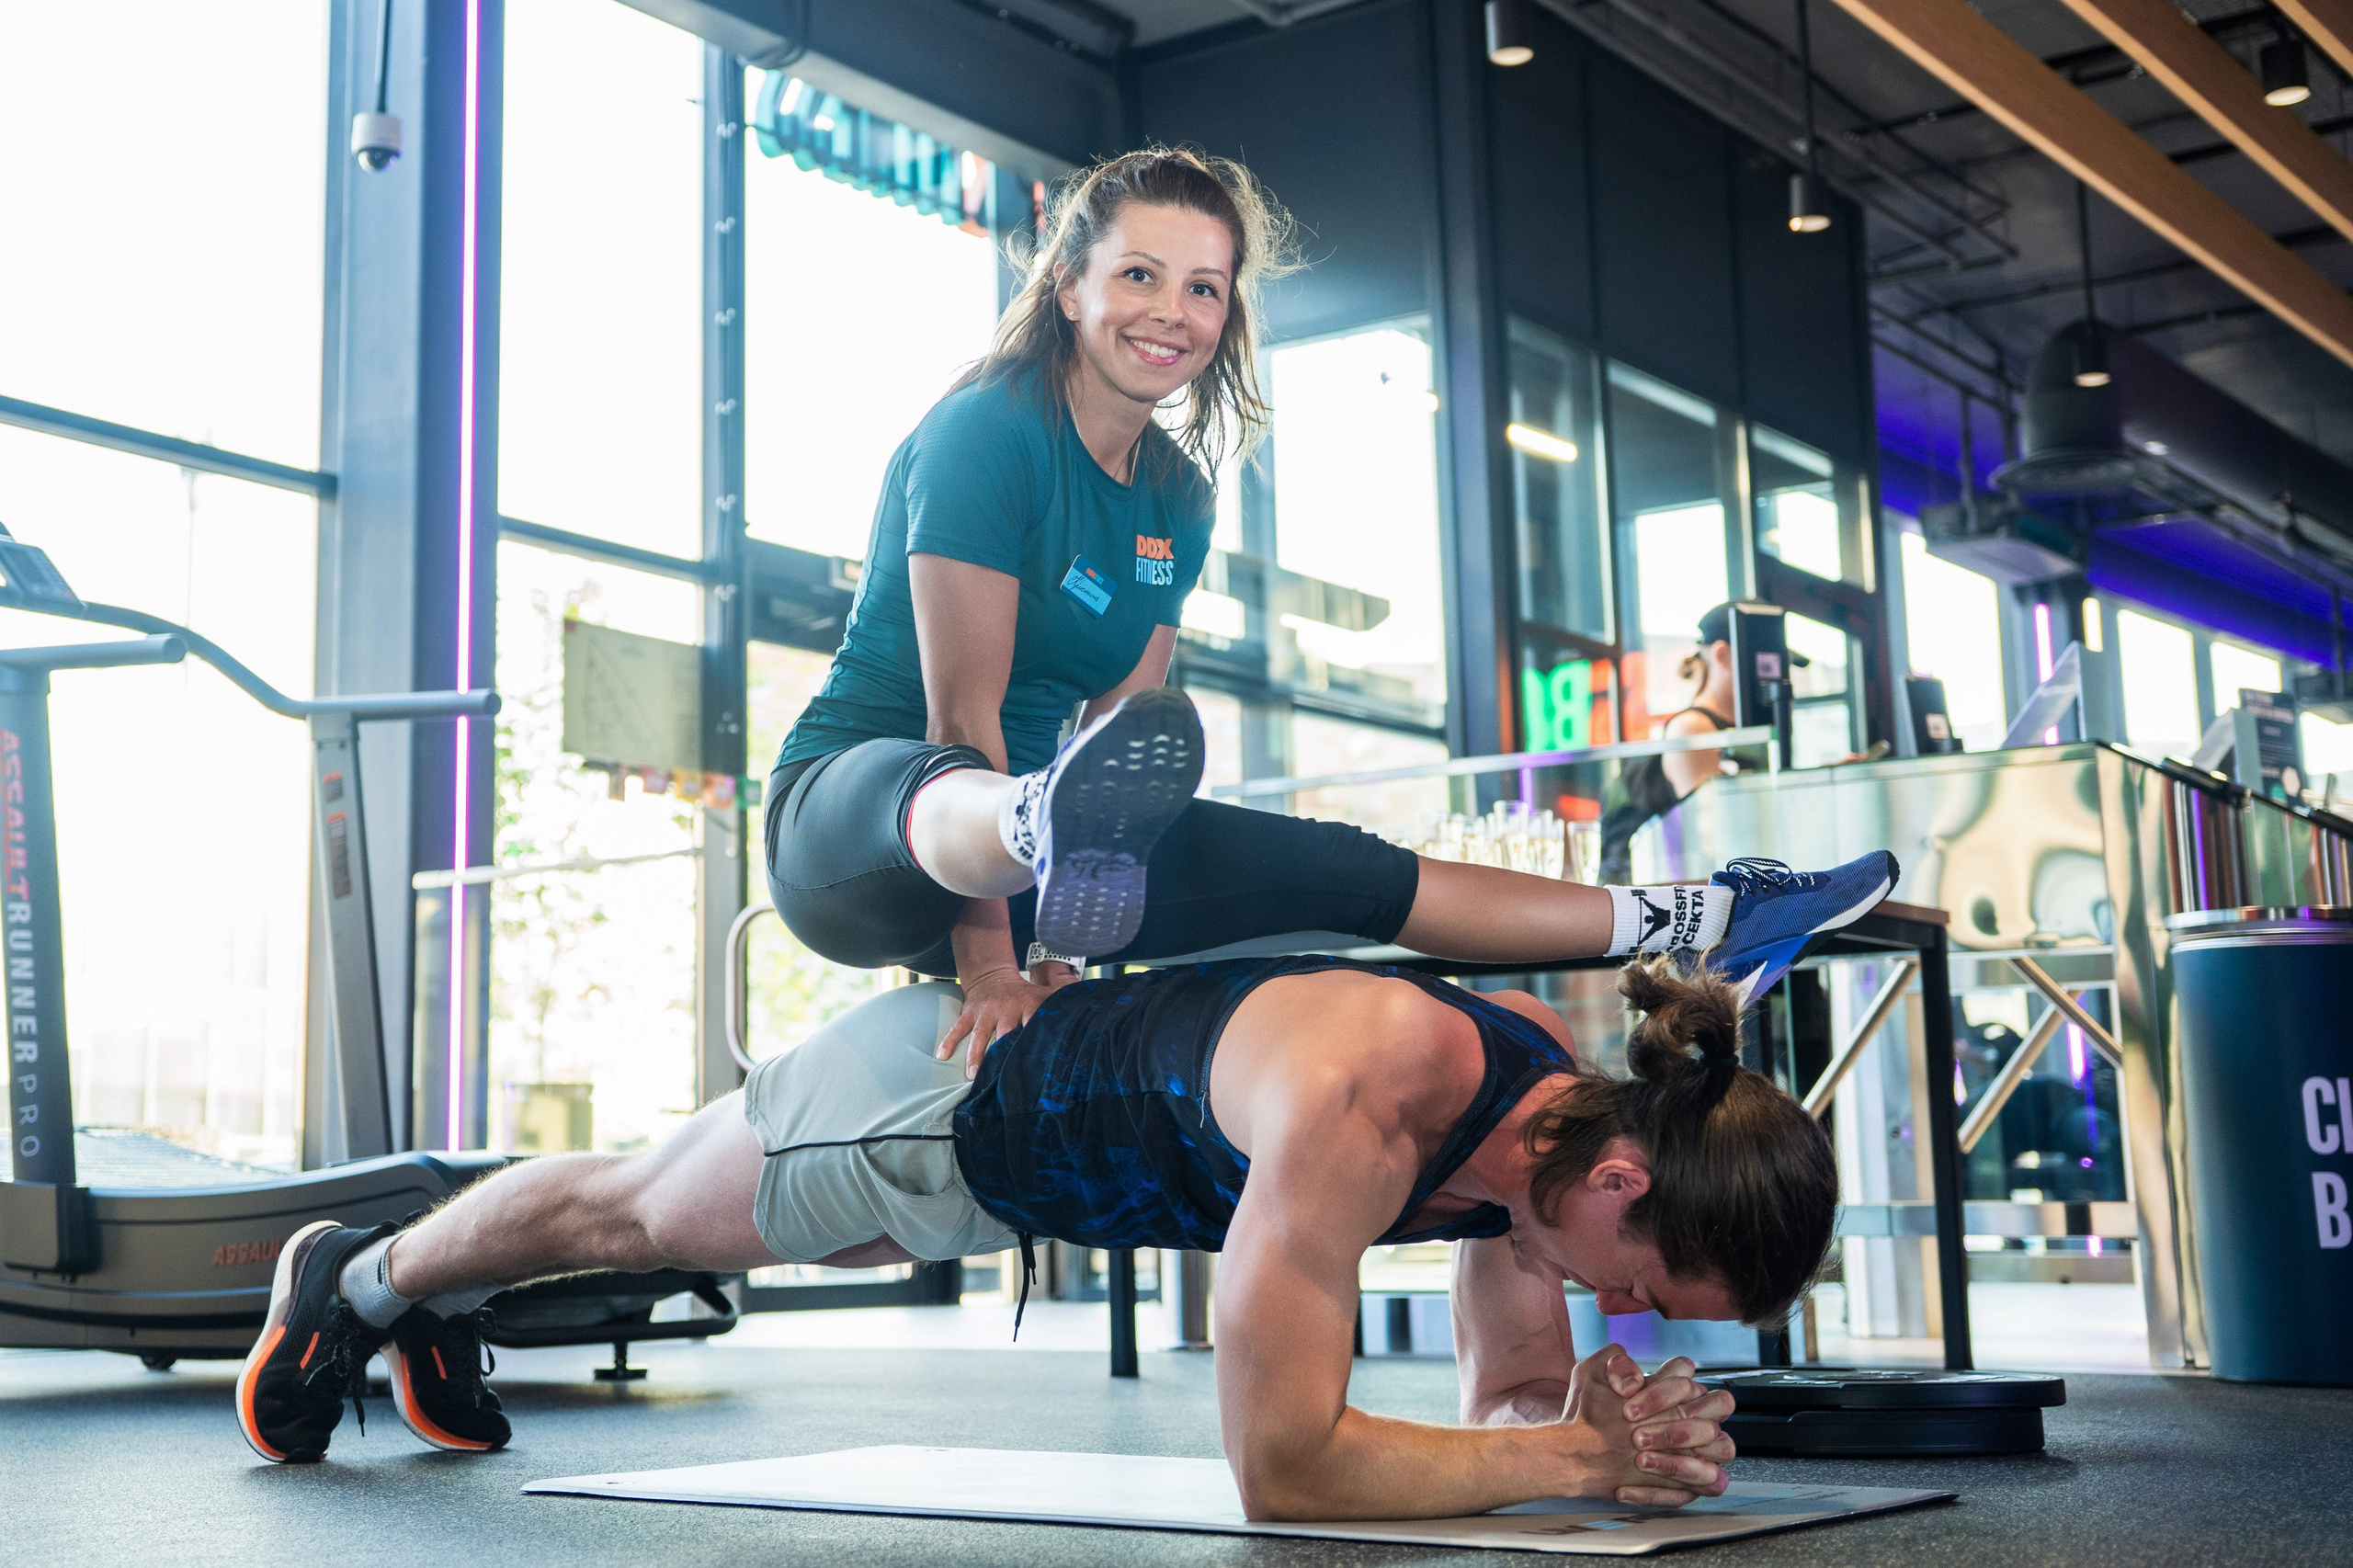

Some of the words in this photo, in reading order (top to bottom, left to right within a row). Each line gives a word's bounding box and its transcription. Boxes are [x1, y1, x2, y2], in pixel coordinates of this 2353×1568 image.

[1136, 534, 1175, 560] DDX
[1136, 557, 1175, 585] FITNESS
[17, 1074, 40, 1158] PRO
